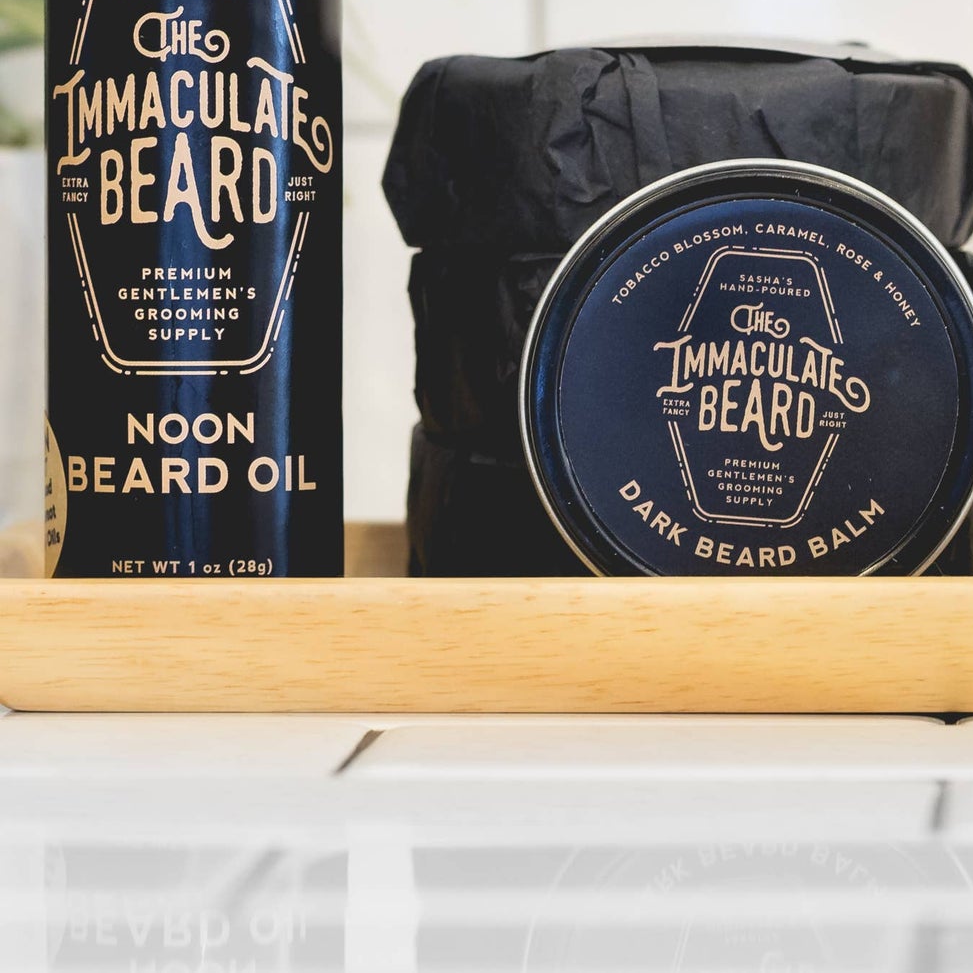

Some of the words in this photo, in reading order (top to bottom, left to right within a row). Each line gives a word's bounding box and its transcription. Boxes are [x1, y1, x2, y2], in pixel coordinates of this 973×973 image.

[132, 6, 231, 63] THE
[52, 56, 333, 175] IMMACULATE
[62, 178, 89, 189] EXTRA
[287, 176, 314, 187] JUST
[62, 192, 89, 203] FANCY
[100, 132, 278, 250] BEARD
[285, 190, 316, 202] RIGHT
[142, 267, 232, 281] PREMIUM
[739, 274, 793, 286] SASHA'S
[612, 251, 670, 305] TOBACCO
[836, 243, 873, 272] ROSE
[873, 270, 884, 282] &
[885, 281, 921, 327] HONEY
[719, 282, 811, 298] HAND-POURED
[118, 287, 257, 301] GENTLEMEN'S
[134, 308, 240, 321] GROOMING
[730, 302, 790, 339] THE
[148, 328, 226, 341] SUPPLY
[654, 334, 871, 413] IMMACULATE
[663, 398, 691, 409] EXTRA
[662, 407, 691, 417] FANCY
[698, 379, 816, 451] BEARD
[822, 410, 846, 420] JUST
[127, 412, 255, 445] NOON
[819, 419, 848, 429] RIGHT
[724, 457, 781, 471] PREMIUM
[68, 455, 230, 494] BEARD
[247, 455, 318, 493] OIL
[707, 469, 796, 484] GENTLEMEN'S
[717, 482, 784, 496] GROOMING
[725, 494, 774, 507] SUPPLY
[618, 479, 689, 547] DARK
[694, 535, 797, 568] BEARD
[807, 498, 886, 559] BALM
[112, 560, 145, 574] NET
[152, 560, 181, 574] WT
[188, 560, 196, 574] 1
[203, 563, 221, 575] oz
[228, 559, 274, 576] (28g)
